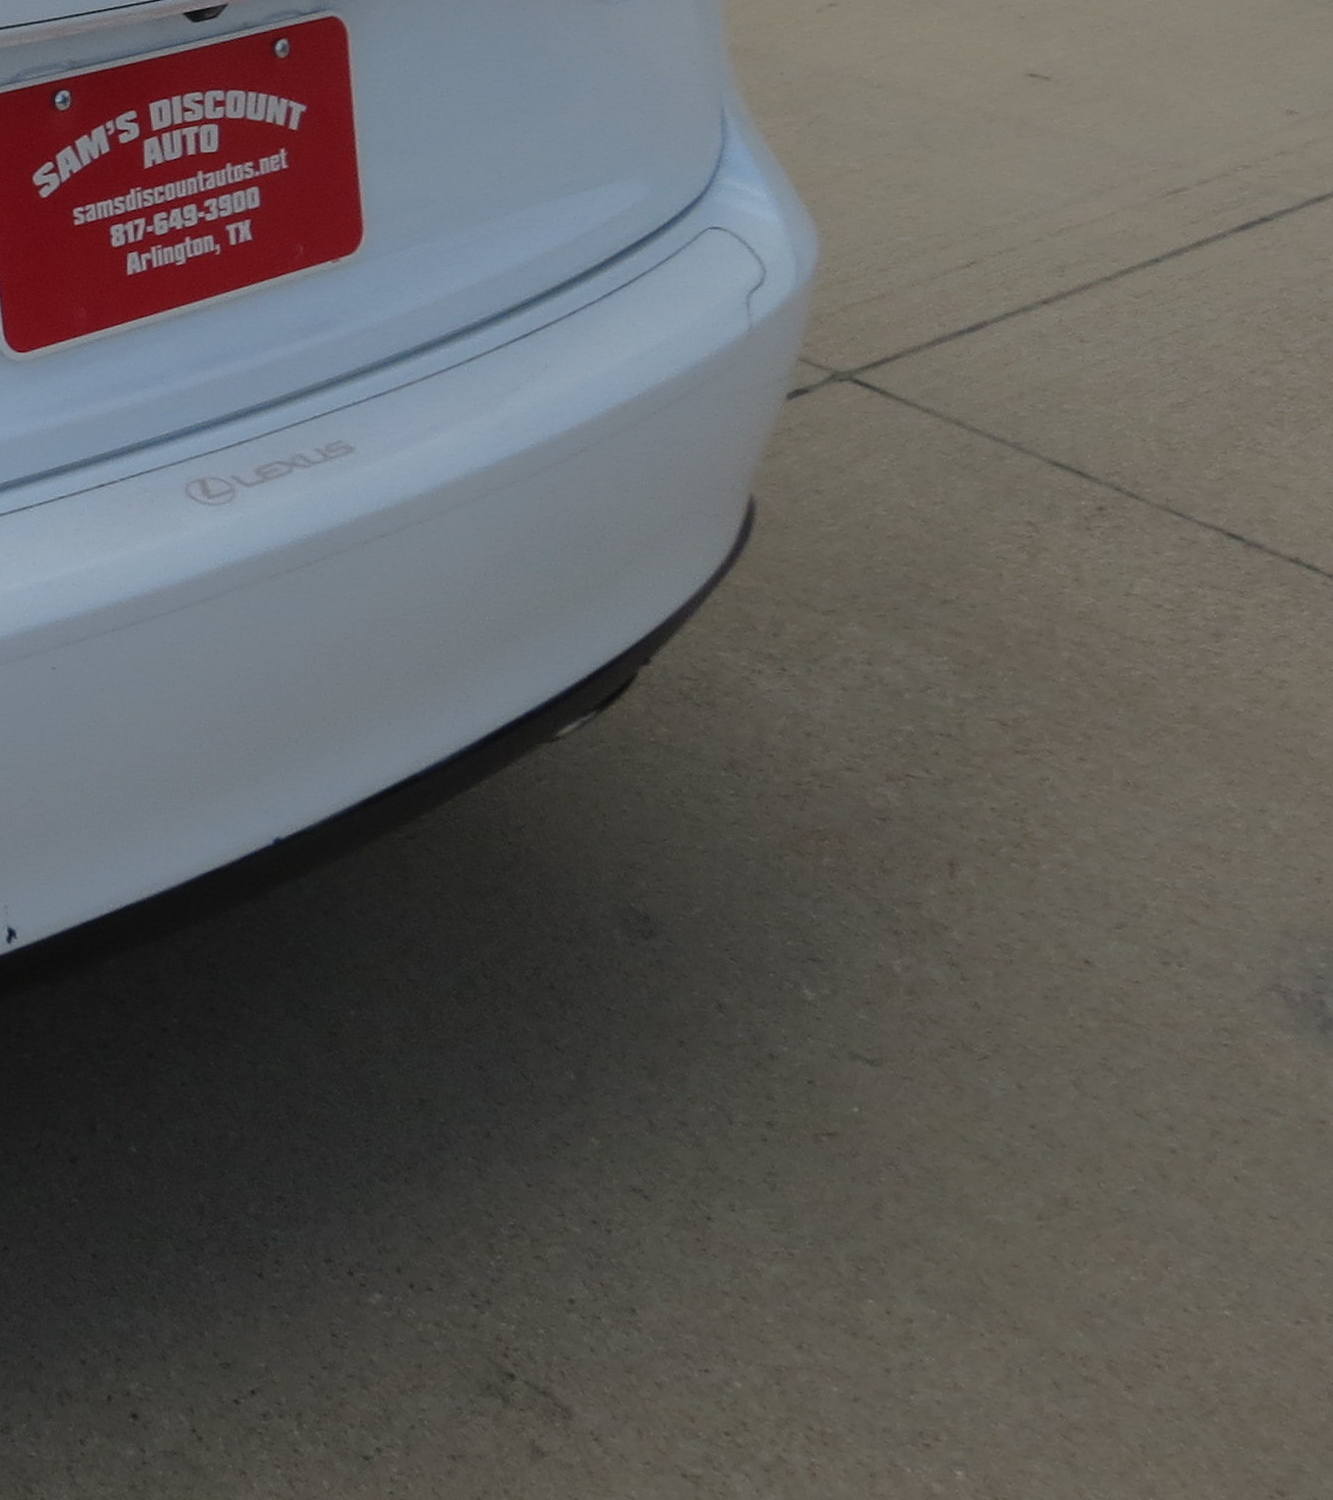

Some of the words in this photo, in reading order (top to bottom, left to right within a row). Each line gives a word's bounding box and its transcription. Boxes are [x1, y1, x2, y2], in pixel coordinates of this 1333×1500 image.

[33, 110, 140, 198] SAM'S
[149, 89, 307, 131] DISCOUNT
[143, 123, 219, 169] AUTO
[73, 148, 288, 226] samsdiscountautos.net
[110, 186, 261, 248] 817-649-3900
[126, 235, 221, 276] Arlington,
[225, 219, 253, 246] TX
[231, 440, 357, 488] LEXUS
